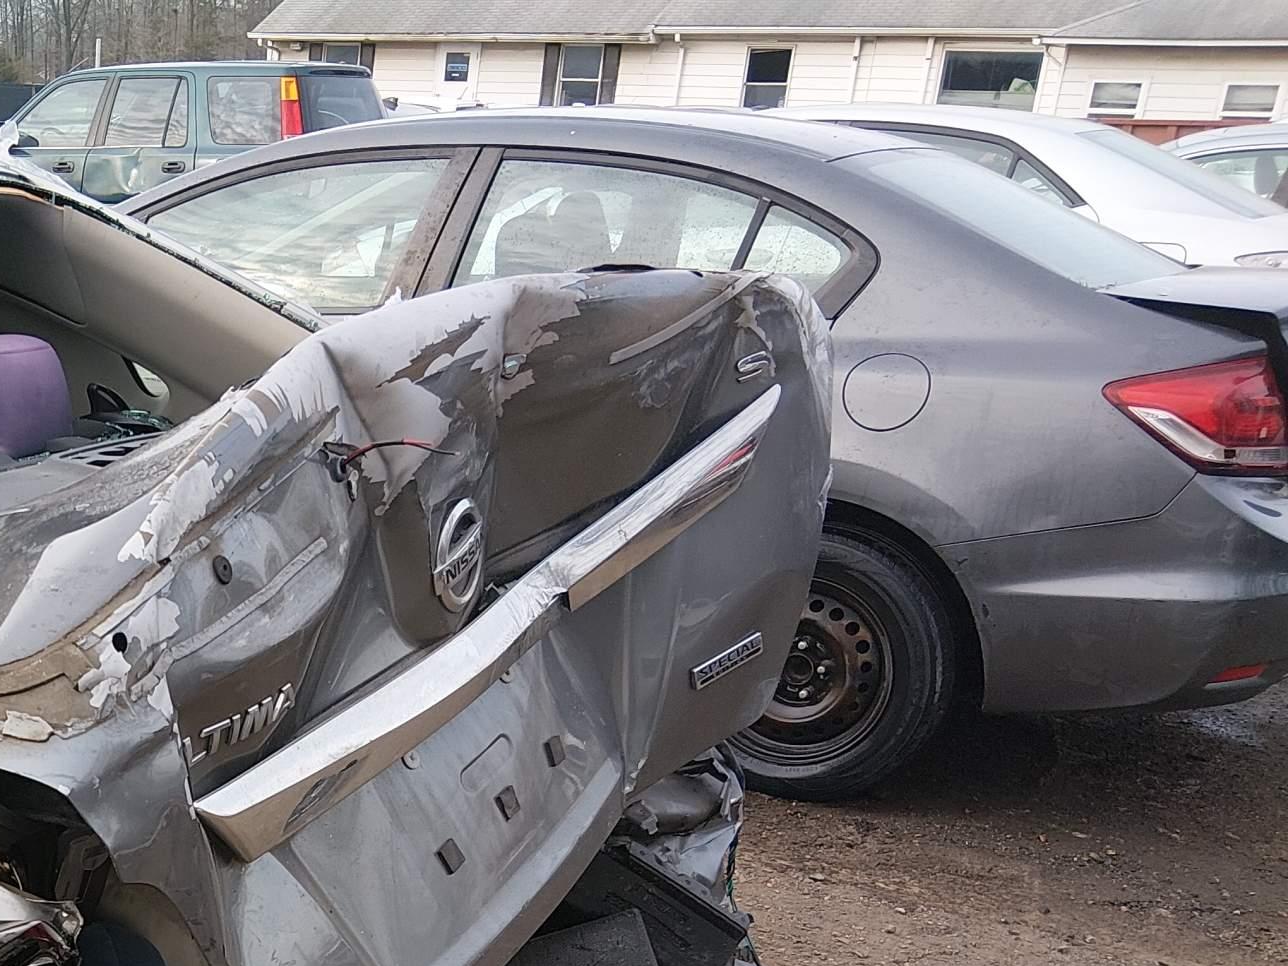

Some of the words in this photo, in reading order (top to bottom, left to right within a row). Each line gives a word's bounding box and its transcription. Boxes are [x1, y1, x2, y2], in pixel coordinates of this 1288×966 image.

[444, 537, 481, 585] NISSA
[698, 638, 761, 677] SPECIAL
[181, 682, 296, 768] LTIMA
